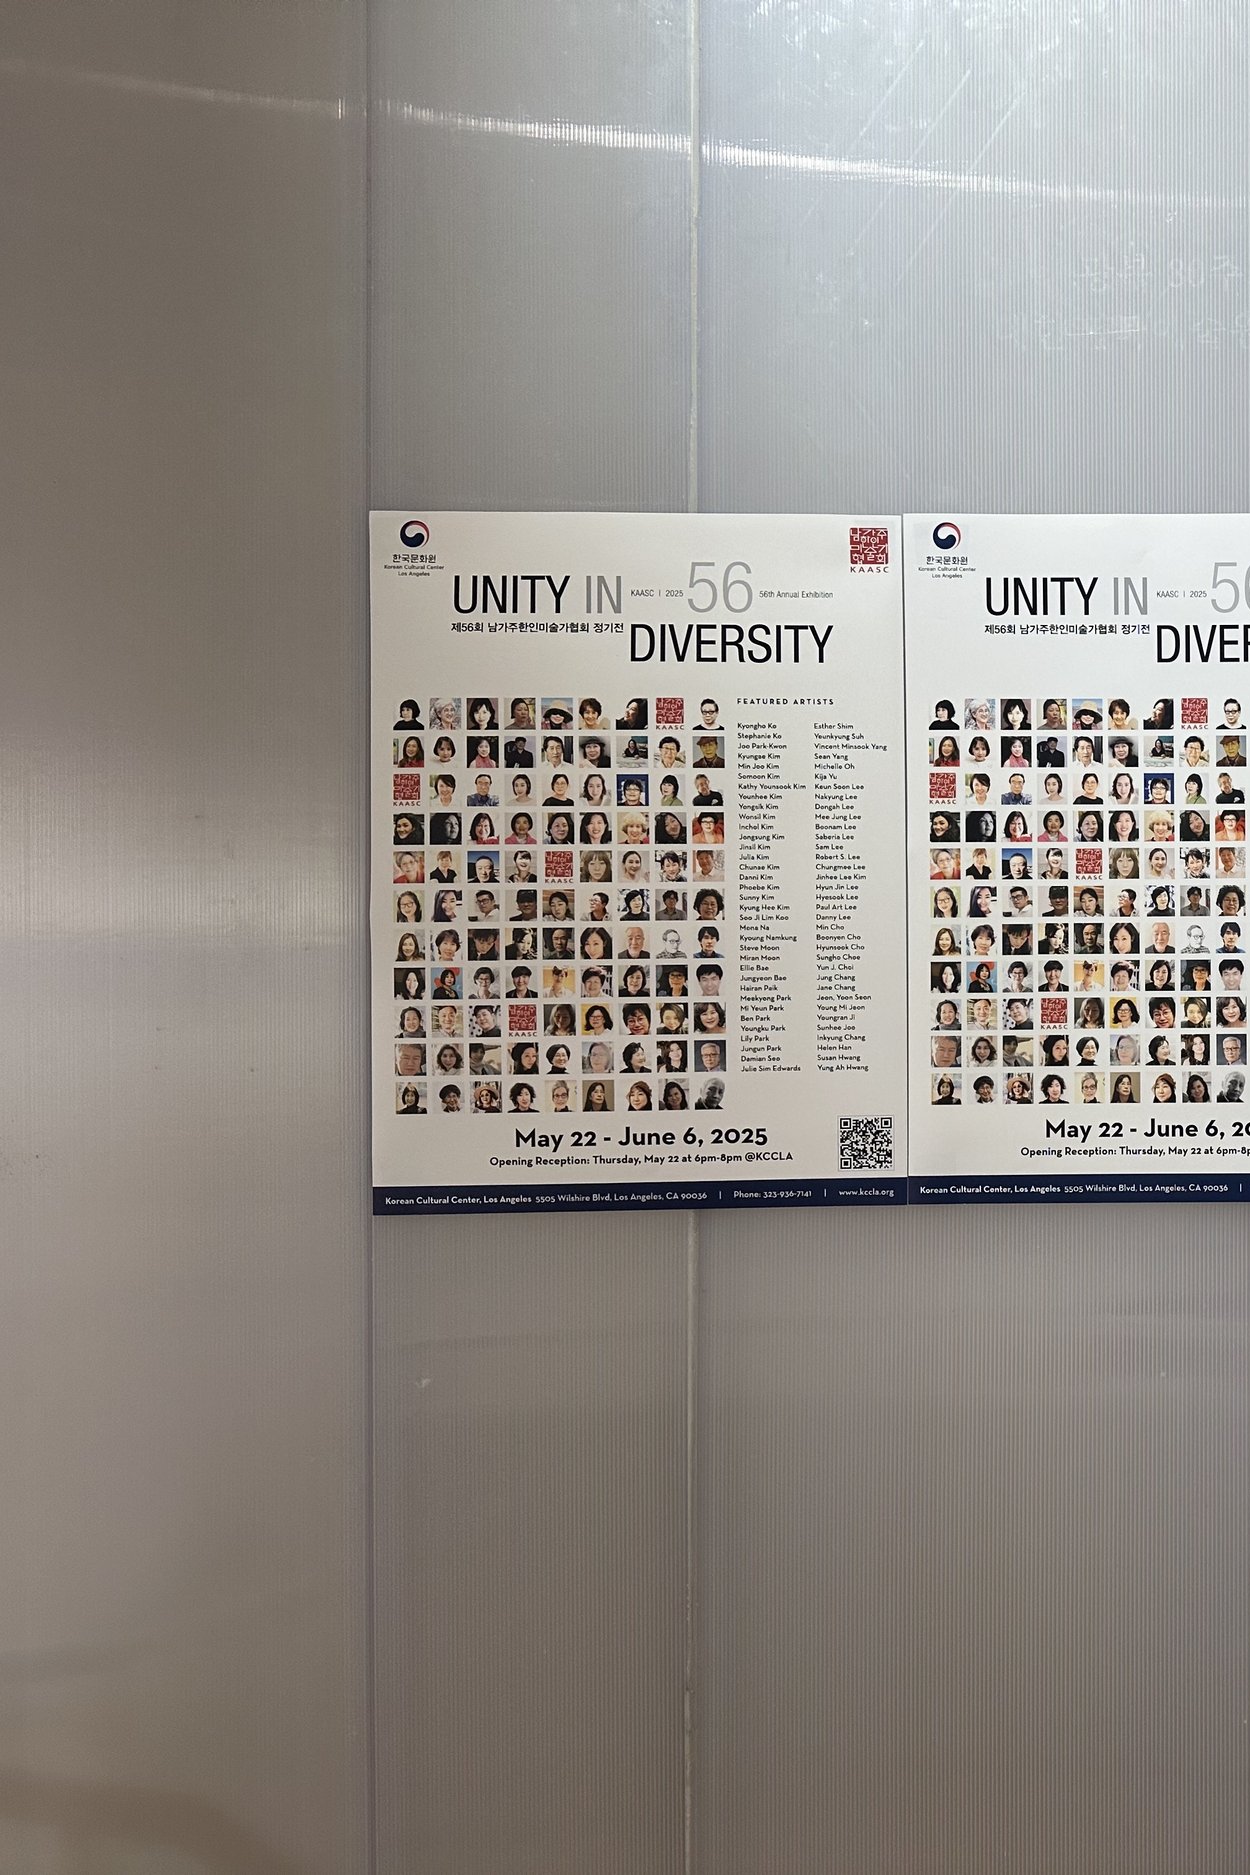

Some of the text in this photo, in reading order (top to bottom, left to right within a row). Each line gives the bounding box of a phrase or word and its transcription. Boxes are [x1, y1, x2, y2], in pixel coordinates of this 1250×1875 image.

[392, 553, 437, 564] 한국문화원
[926, 556, 969, 566] 한국문화원
[850, 566, 889, 574] KAASC
[630, 589, 684, 598] KAASC 2025
[687, 561, 754, 614] 56
[453, 575, 623, 615] UNITY IN
[759, 590, 834, 599] 56th Annual Exhibition
[986, 577, 1149, 617] UNITY IN
[1156, 590, 1208, 599] KAASC 2025
[450, 622, 624, 634] 제56회 남가주한인미술가협회 정기전
[984, 624, 1151, 636] 제56회 남가주한인미술가협회 정기전
[630, 623, 834, 664] DIVERSITY
[737, 698, 834, 706] FEATURED ARTISTS
[737, 732, 783, 741] Stephanie Ko
[741, 1064, 802, 1073] Julie Sim Edwards
[1046, 1119, 1093, 1144] May
[1098, 1122, 1124, 1138] 22
[1143, 1118, 1199, 1138] June
[1205, 1119, 1226, 1141] 6,
[515, 1128, 565, 1153] May
[570, 1131, 597, 1148] 22
[618, 1126, 676, 1147] June
[683, 1127, 704, 1148] 6,
[710, 1128, 768, 1147] 2025
[1020, 1147, 1063, 1159] Opening
[1064, 1146, 1117, 1158] Reception:
[1119, 1145, 1166, 1158] Thursday,
[1168, 1146, 1189, 1158] May
[1190, 1147, 1202, 1155] 22
[1203, 1146, 1214, 1155] at
[489, 1151, 794, 1169] Opening Reception: Thursday, May 22 at 6pm-8pm @KCCLA
[920, 1186, 949, 1194] Korean
[949, 1185, 982, 1194] Cultural
[983, 1185, 1013, 1194] Center,
[1014, 1185, 1029, 1193] Los
[1030, 1184, 1061, 1195] Angeles
[1064, 1185, 1084, 1194] 5505
[1085, 1184, 1117, 1192] Wilshire
[1118, 1184, 1138, 1193] Blvd,
[1139, 1184, 1154, 1192] Los
[1154, 1184, 1188, 1194] Angeles,
[1188, 1183, 1202, 1192] CA
[1203, 1184, 1229, 1193] 90036
[385, 1187, 895, 1205] Korean Cultural Center, Los Angeles 5505 Wilshire Blvd, Los Angeles, CA 90036 Phone: 323-936-7141 www.kccla.org
